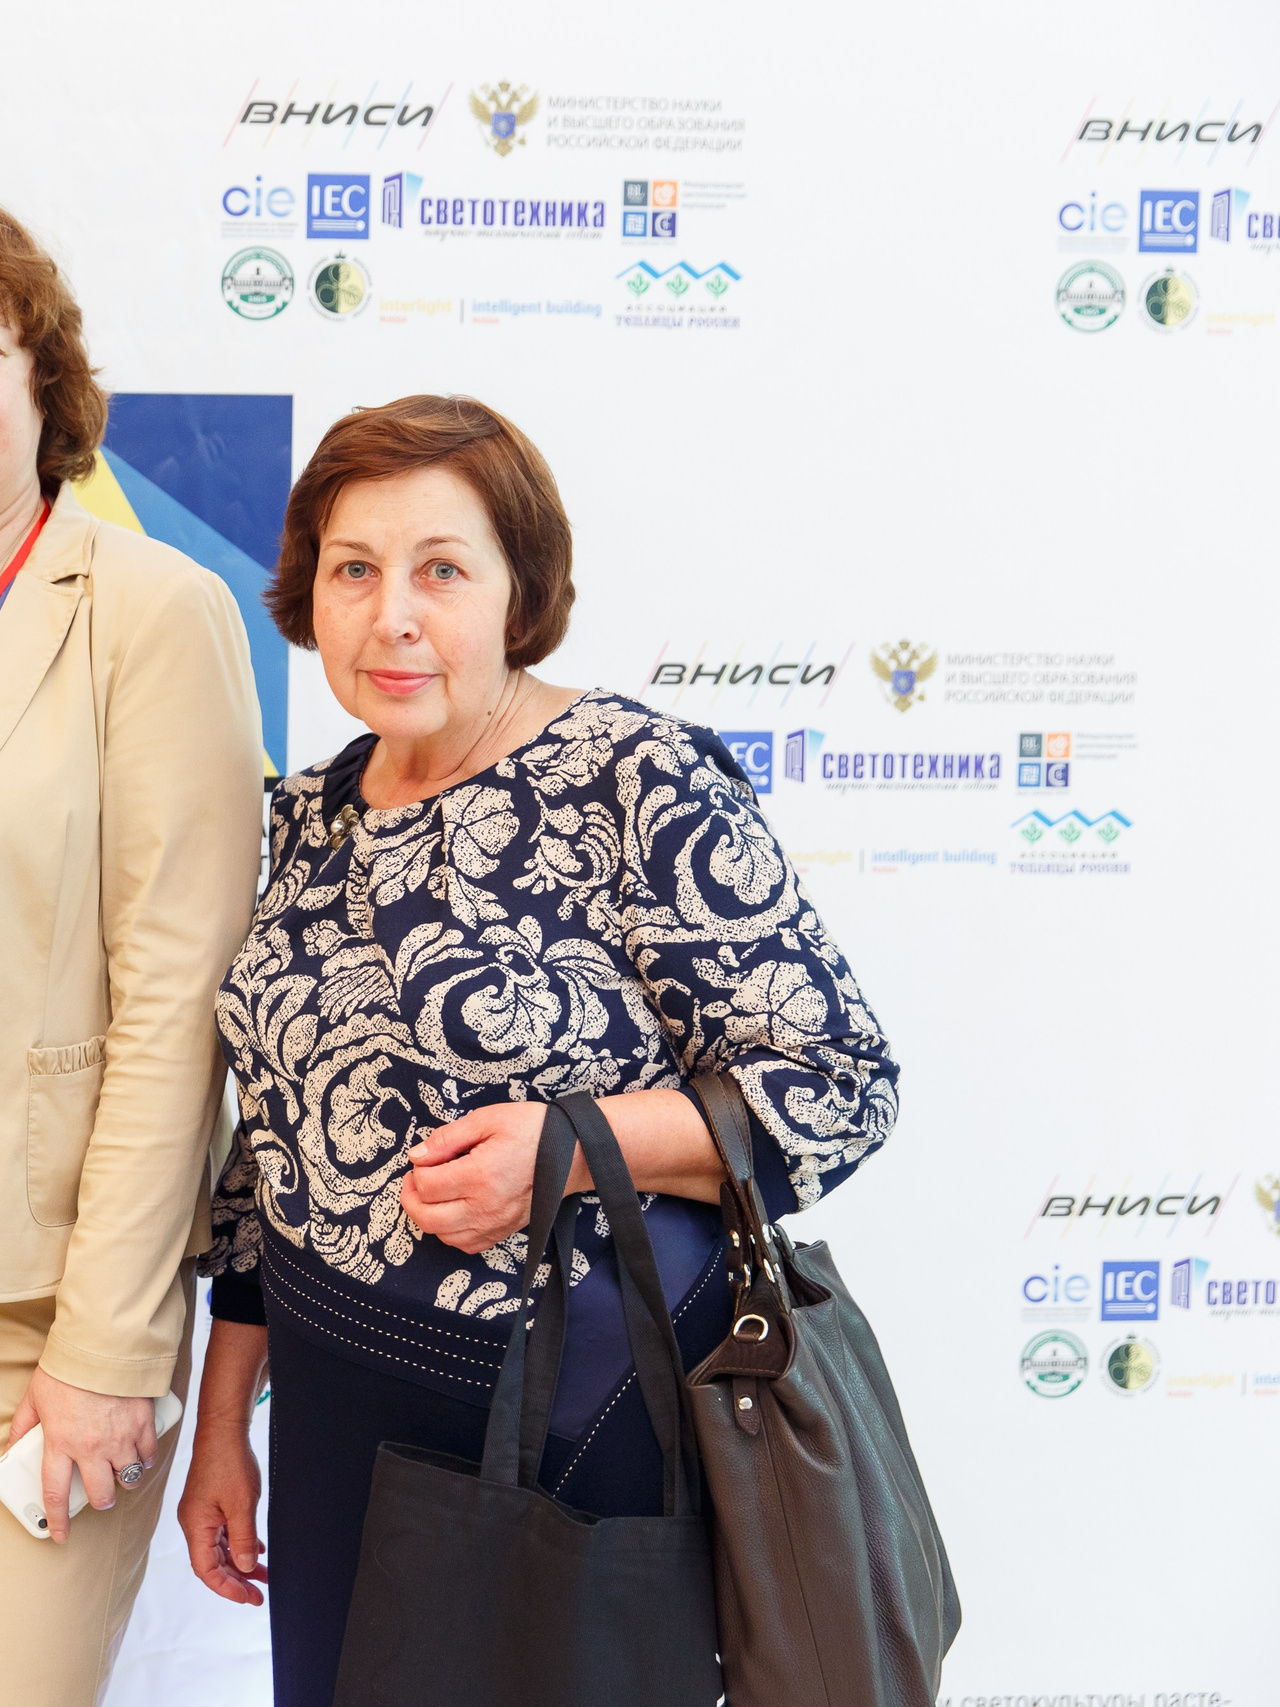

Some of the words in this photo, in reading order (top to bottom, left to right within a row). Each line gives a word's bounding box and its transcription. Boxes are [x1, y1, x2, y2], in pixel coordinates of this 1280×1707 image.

[240, 101, 434, 127] ВНИСИ
[547, 96, 669, 111] МИНИСТЕРСТВО
[672, 98, 722, 111] НАУКИ
[547, 116, 557, 129] И
[562, 115, 634, 130] ВЫСШЕГО
[638, 116, 745, 132] ОБРАЗОВАНИЯ
[1078, 119, 1263, 143] ВНИСИ
[547, 132, 649, 149] РОССИЙСКОЙ
[652, 137, 743, 152] ФЕДЕРАЦИИ
[222, 174, 295, 218] cie
[311, 184, 367, 218] IEC
[1059, 191, 1128, 232] cie
[1142, 199, 1196, 233] IEC
[472, 298, 542, 315] intelligent
[545, 299, 602, 317] building
[650, 663, 835, 685] ВНИСИ
[729, 741, 770, 773] EC
[1041, 1195, 1222, 1217] ВНИСИ
[1023, 1264, 1090, 1302] cie
[1105, 1270, 1157, 1301] IEC
